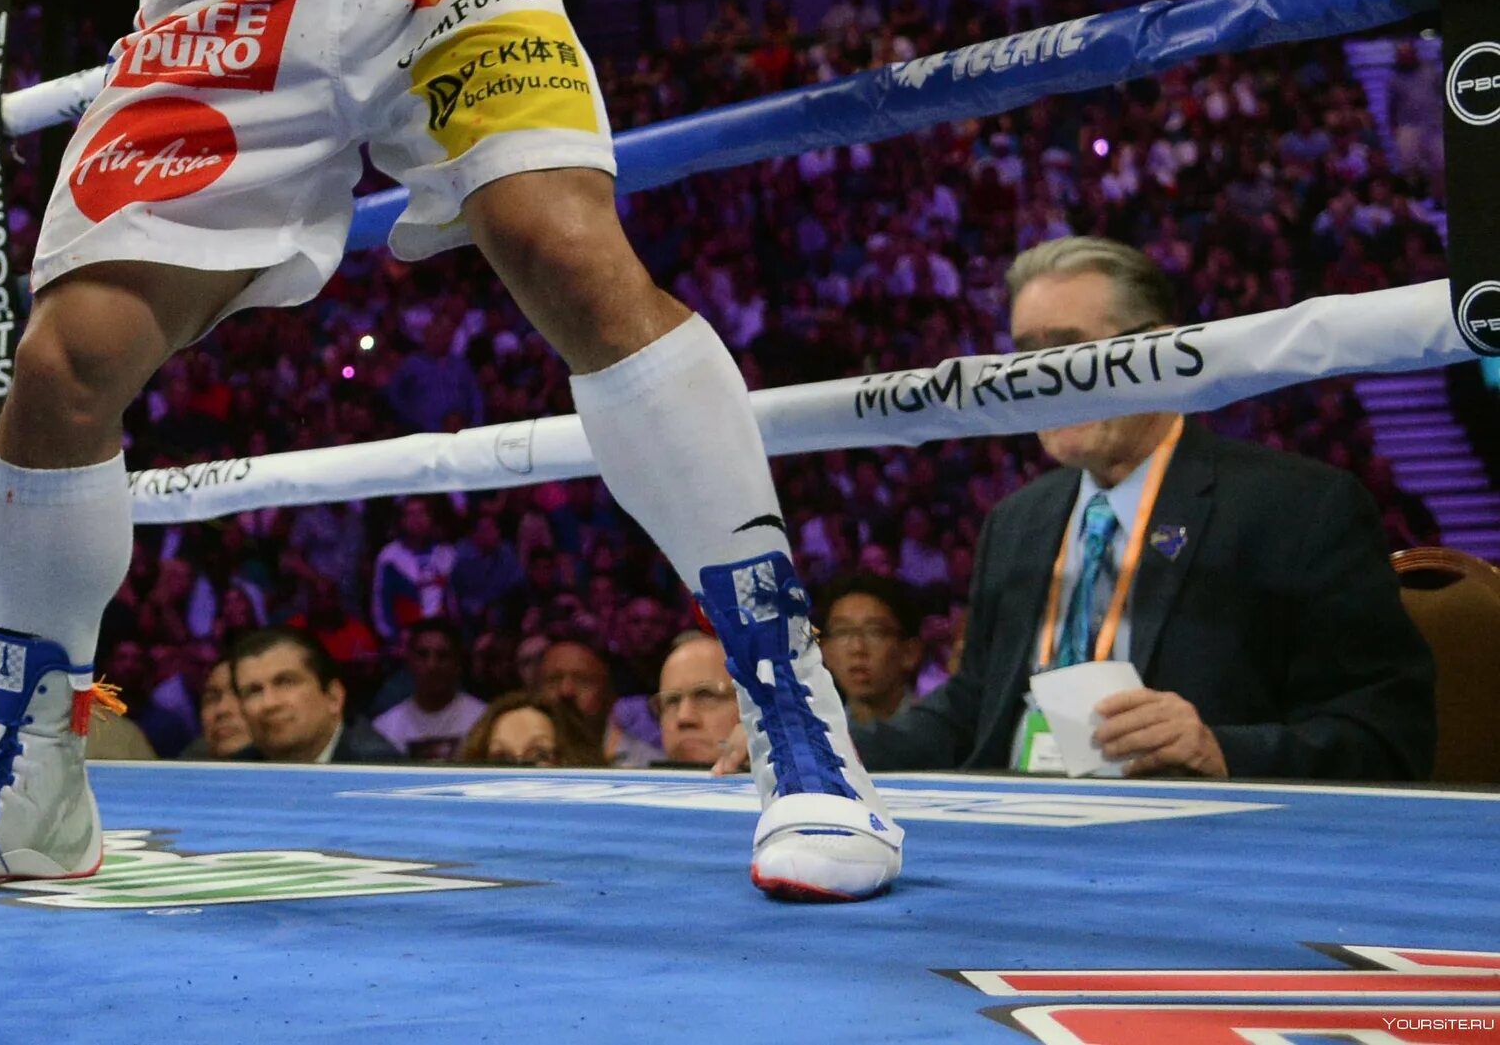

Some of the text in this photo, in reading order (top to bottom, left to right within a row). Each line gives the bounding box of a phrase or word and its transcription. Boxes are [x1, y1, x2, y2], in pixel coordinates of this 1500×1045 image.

[128, 33, 261, 77] PURO
[854, 326, 1205, 419] MGM RESORTS
